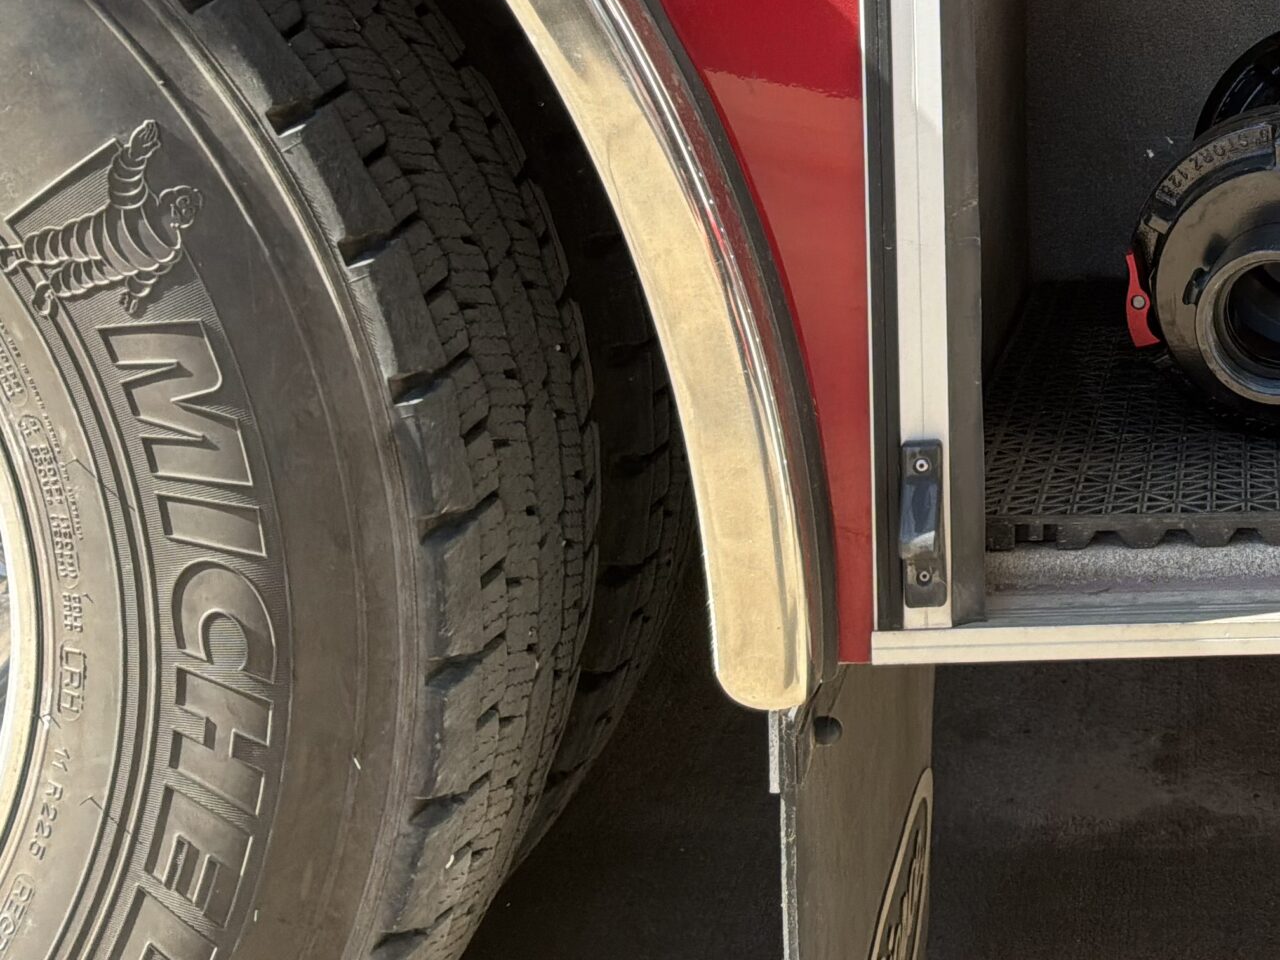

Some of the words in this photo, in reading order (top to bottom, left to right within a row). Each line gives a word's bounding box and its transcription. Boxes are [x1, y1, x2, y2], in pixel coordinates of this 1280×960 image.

[7, 337, 22, 358] USE
[26, 376, 45, 410] NORTH
[41, 412, 62, 455] AMERICA
[59, 461, 70, 482] AND
[65, 485, 84, 541] AUSTRALIA
[60, 646, 82, 713] LRH
